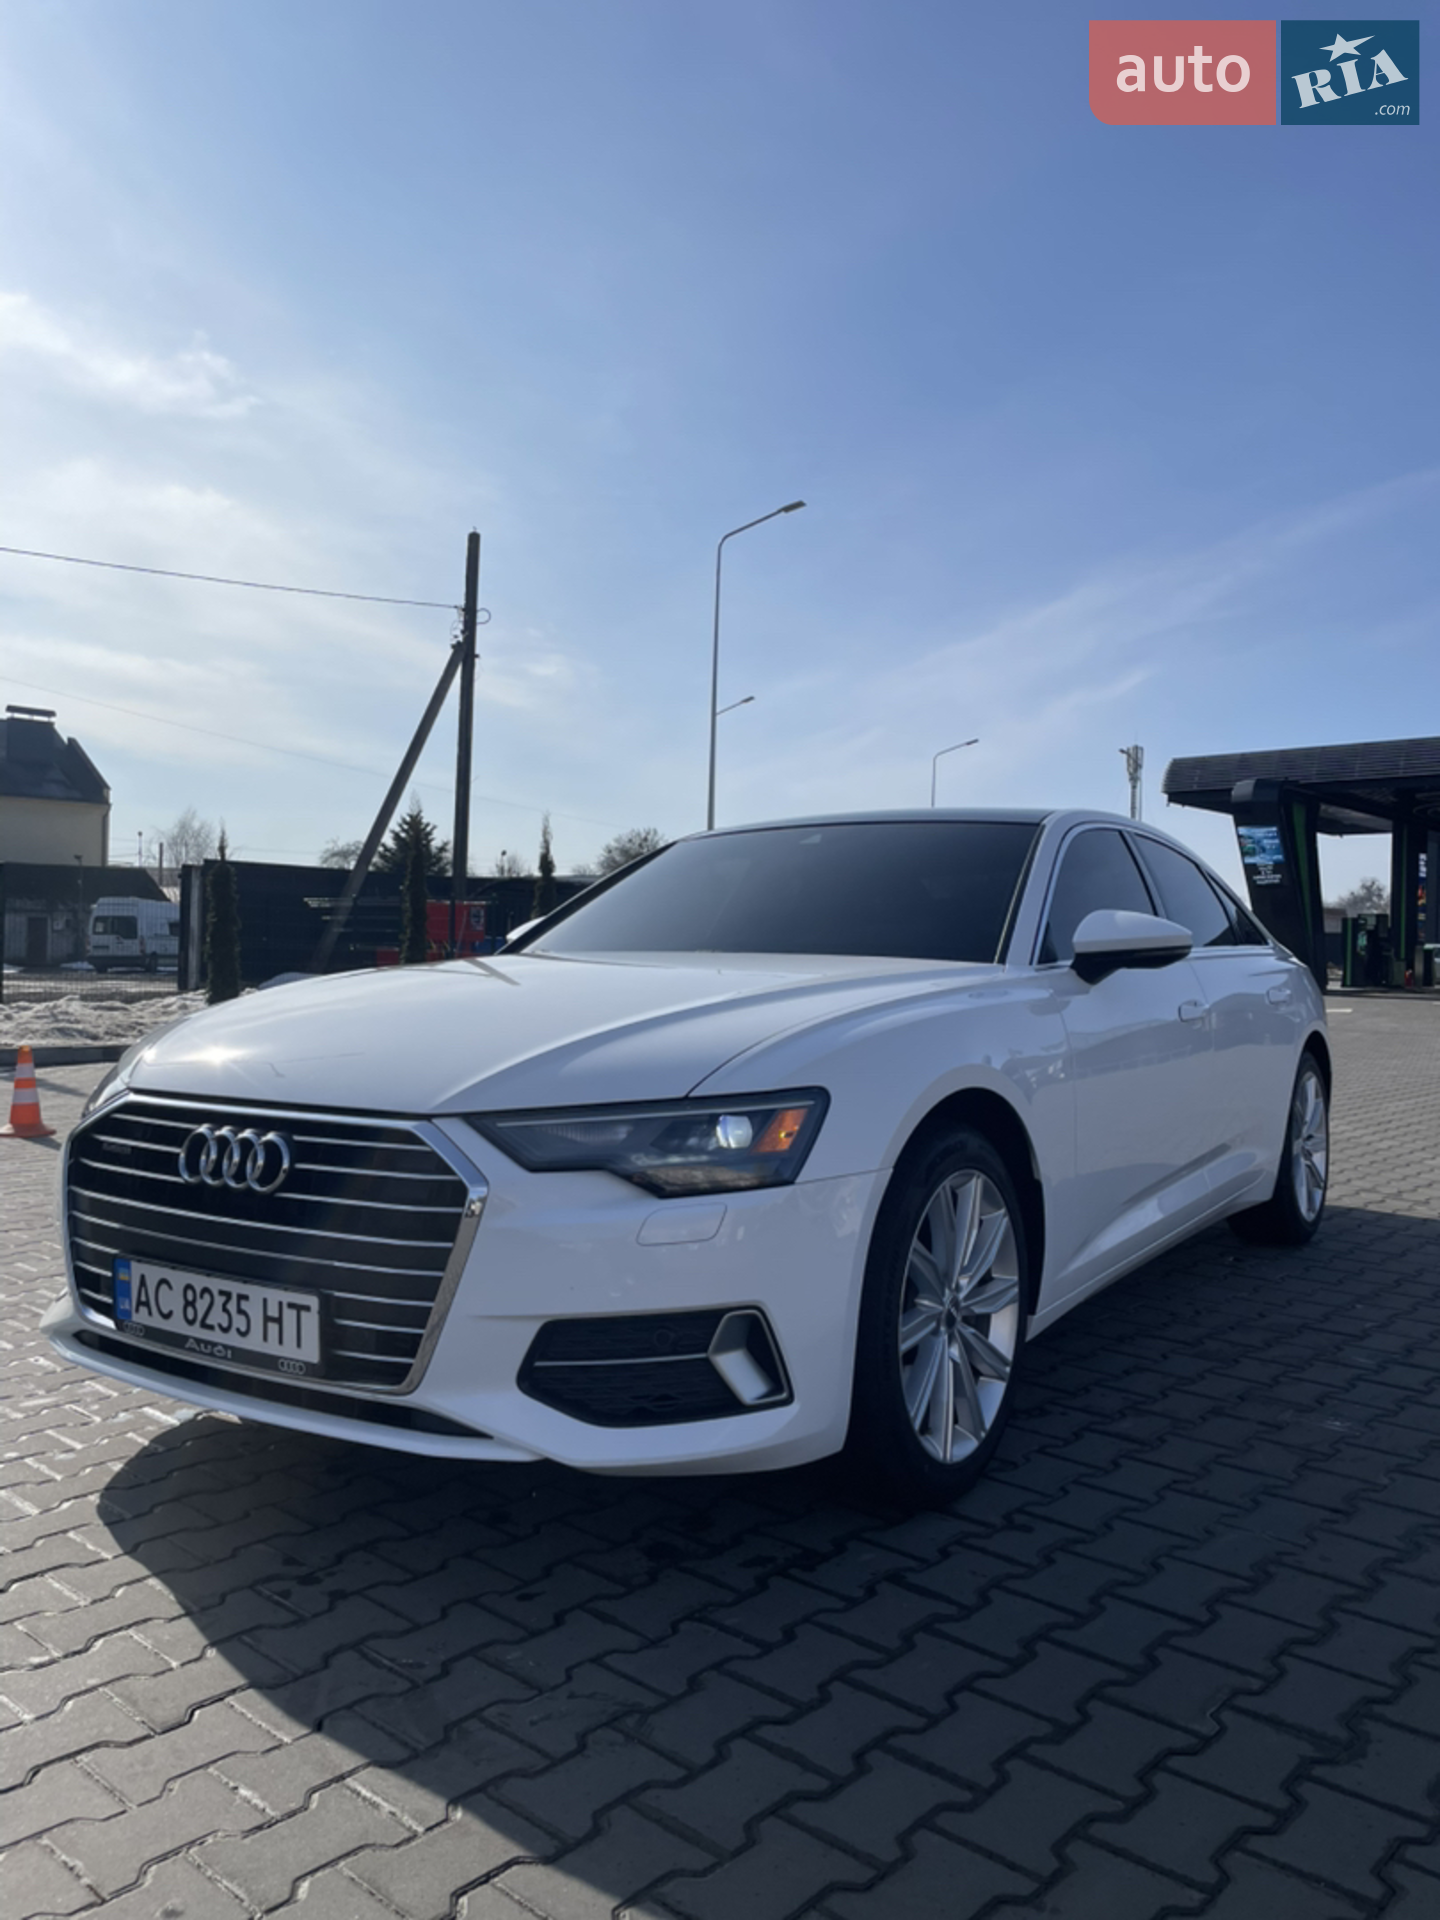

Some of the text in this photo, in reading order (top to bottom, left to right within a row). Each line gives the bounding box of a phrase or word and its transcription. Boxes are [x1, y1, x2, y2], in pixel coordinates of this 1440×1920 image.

[134, 1273, 312, 1349] AC 8235 HT
[184, 1338, 233, 1359] Audi
